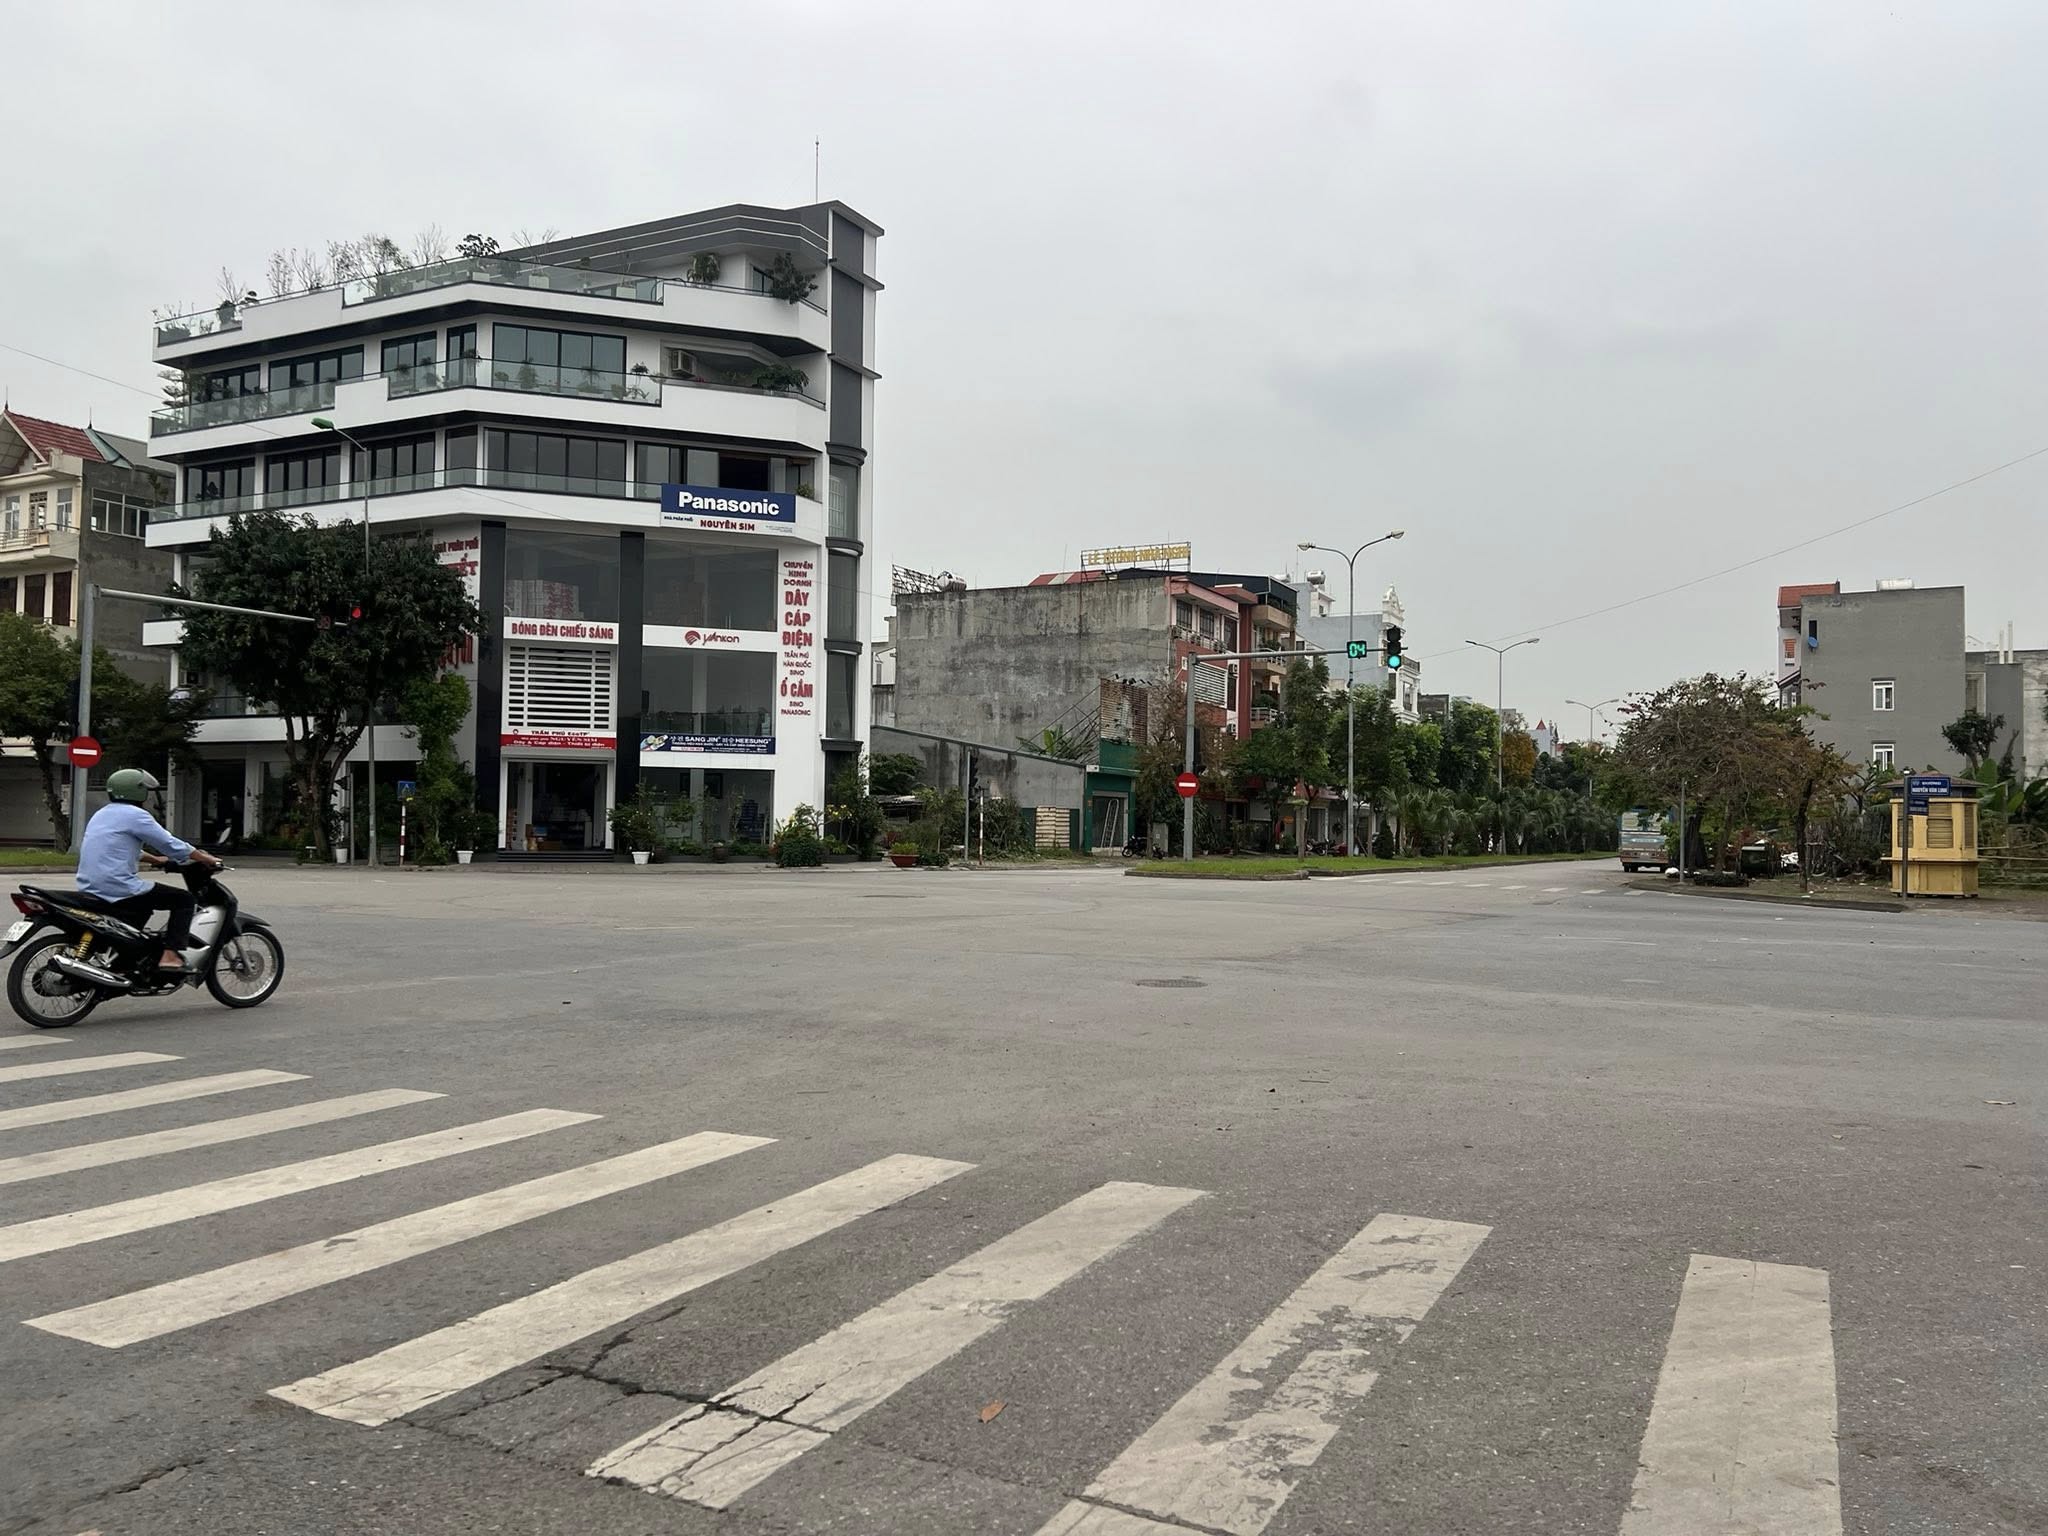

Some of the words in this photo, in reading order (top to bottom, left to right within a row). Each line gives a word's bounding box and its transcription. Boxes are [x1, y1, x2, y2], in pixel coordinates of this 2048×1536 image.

[678, 491, 780, 516] Panasonic
[739, 522, 755, 531] SIM
[789, 570, 807, 578] KINH
[784, 579, 812, 587] DOANH
[785, 589, 809, 606] DÂY
[785, 609, 811, 627] CÁP
[512, 621, 537, 635] BÓNG
[540, 622, 558, 637] ĐÈN
[560, 623, 587, 638] CHIẾU
[589, 625, 613, 639] SÁNG
[782, 629, 813, 649] ĐIỆN
[1349, 643, 1365, 657] 04
[795, 660, 812, 668] QUỐC
[790, 679, 813, 698] CẮM
